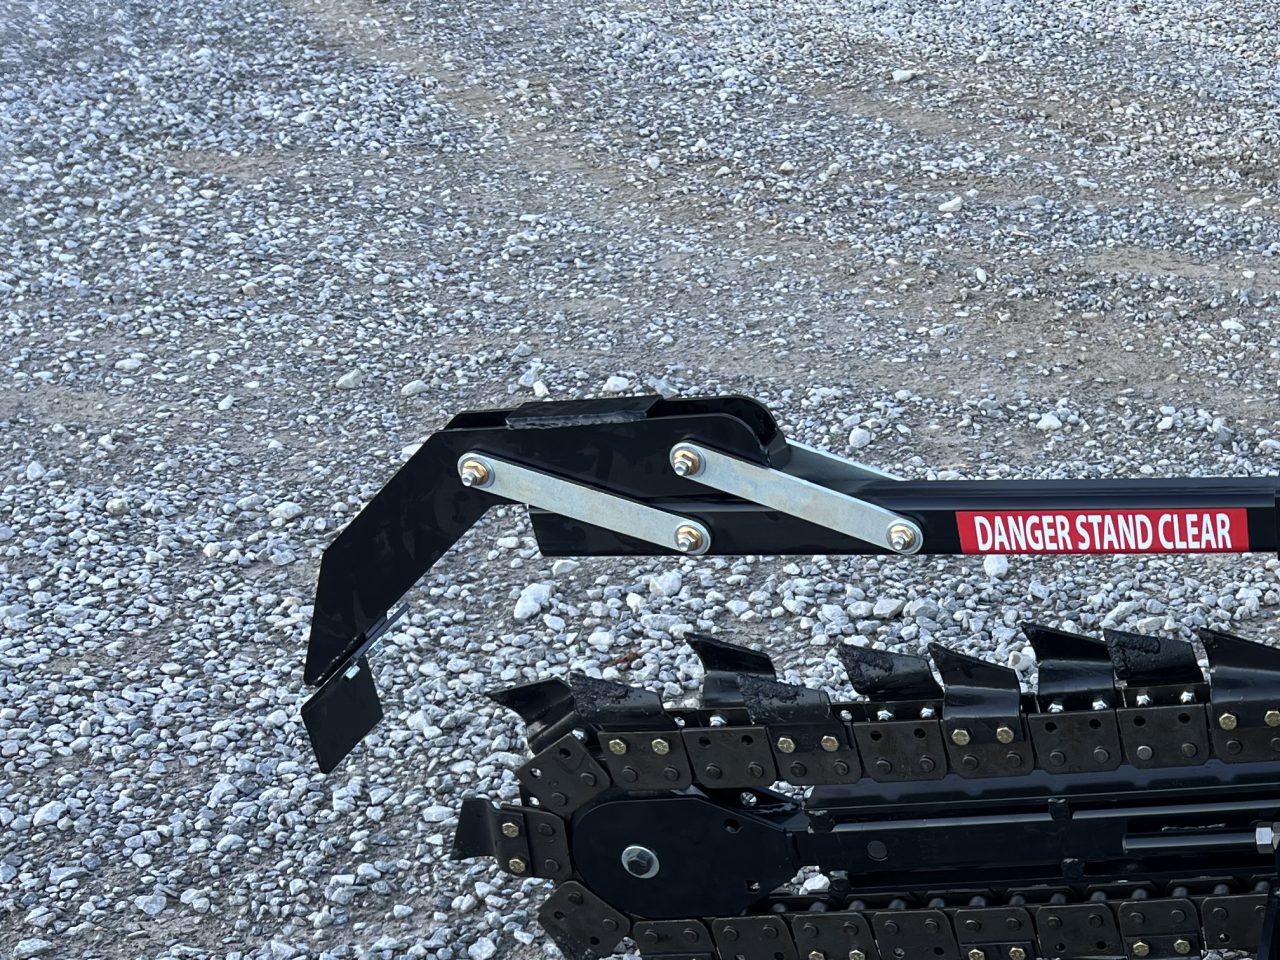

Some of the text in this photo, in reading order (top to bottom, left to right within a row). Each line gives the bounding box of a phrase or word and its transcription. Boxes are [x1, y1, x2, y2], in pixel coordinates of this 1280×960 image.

[974, 512, 1233, 551] DANGER STAND CLEAR
